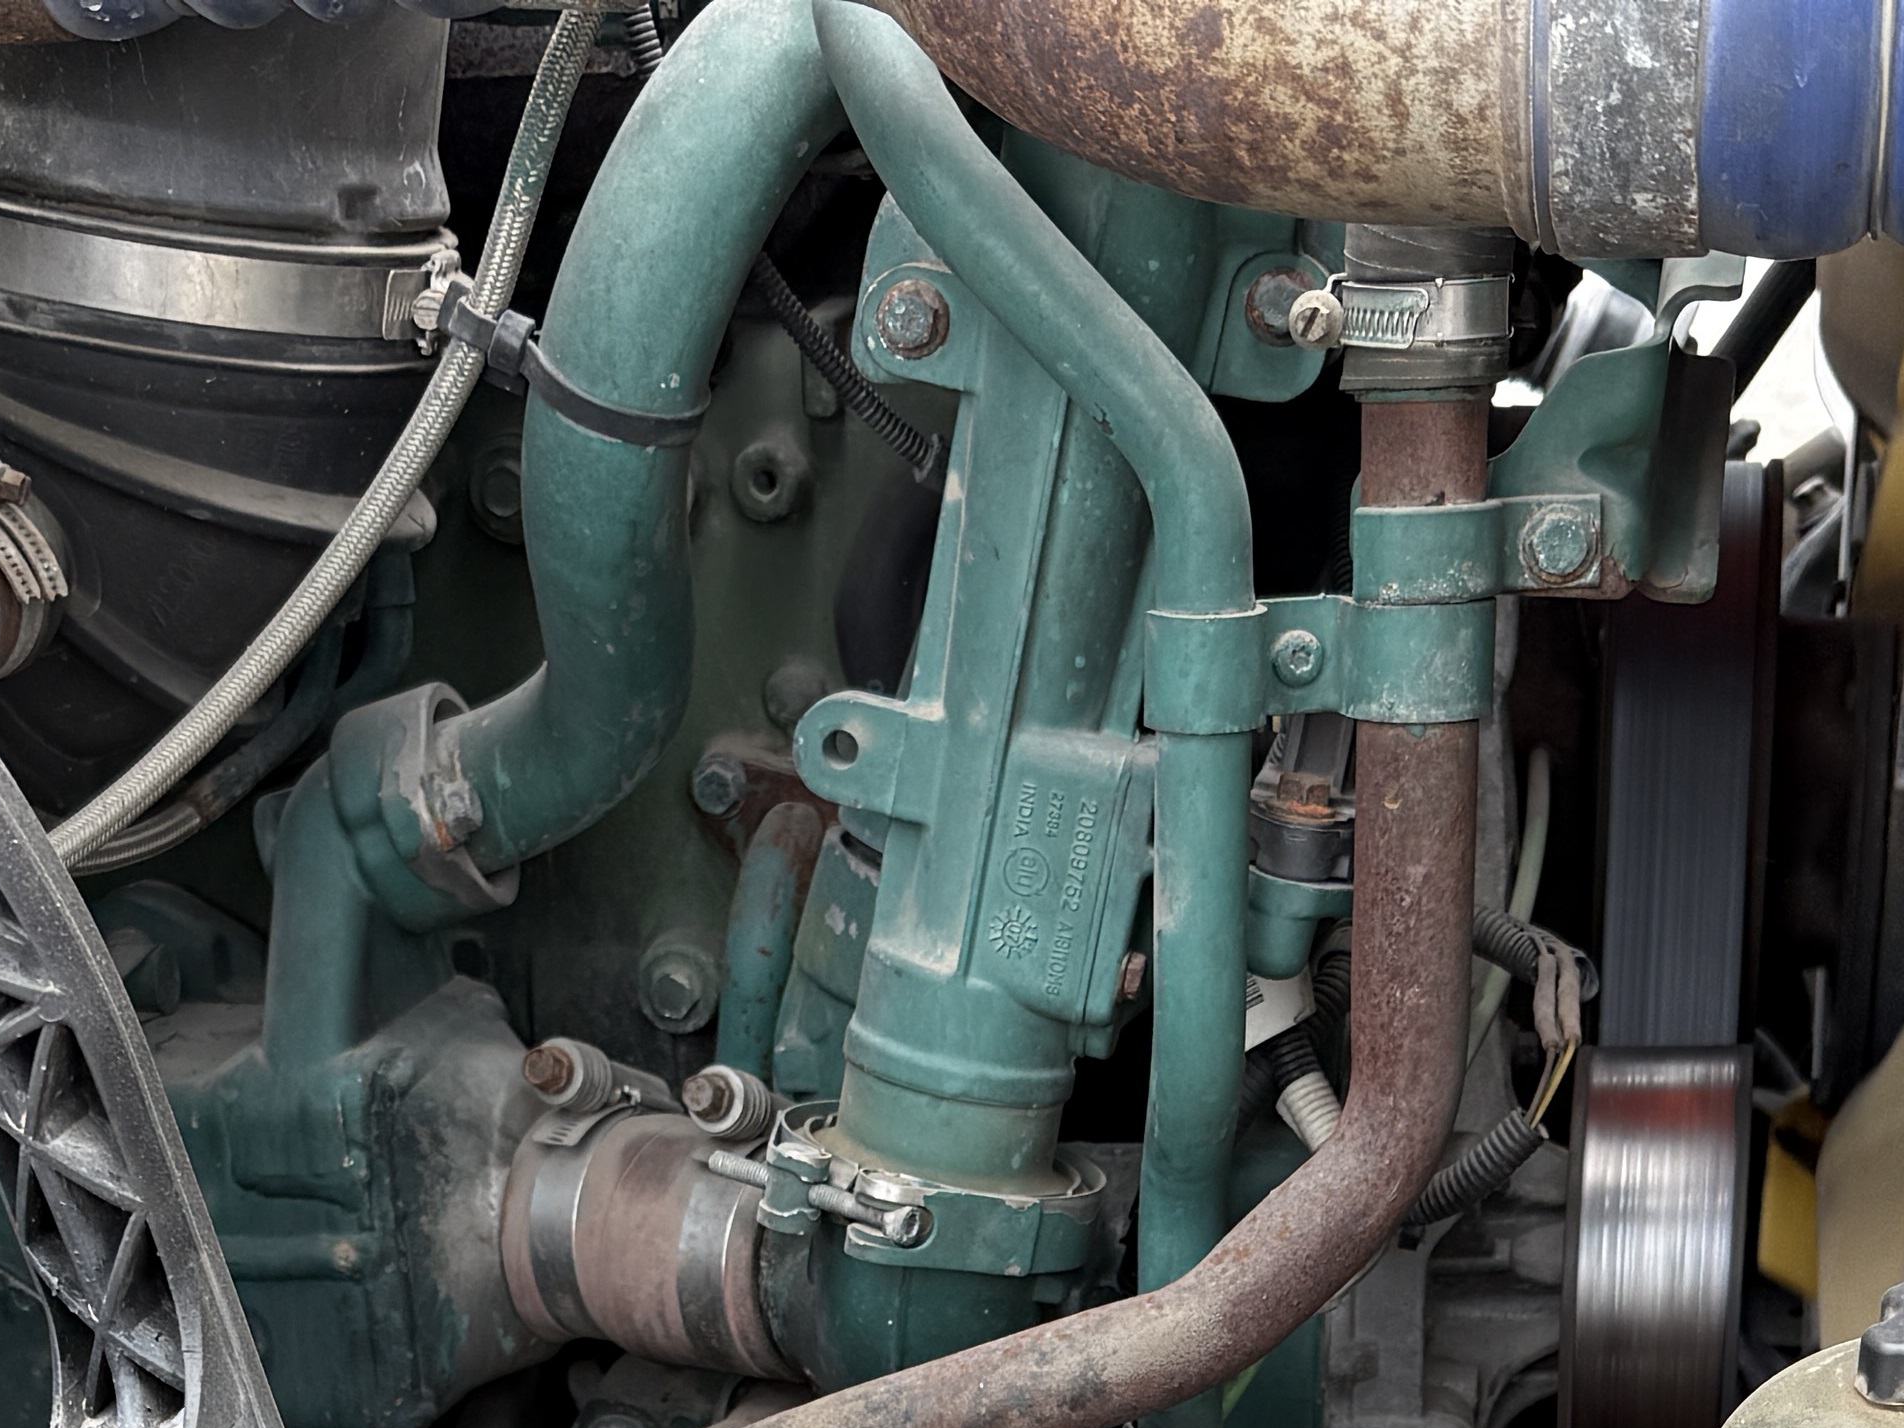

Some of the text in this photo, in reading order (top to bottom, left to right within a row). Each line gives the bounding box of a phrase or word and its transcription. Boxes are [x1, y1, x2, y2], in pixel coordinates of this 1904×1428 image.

[1013, 782, 1038, 838] INDIA
[1016, 855, 1041, 889] alu
[1061, 798, 1099, 913] 20809752
[1006, 923, 1024, 946] 07
